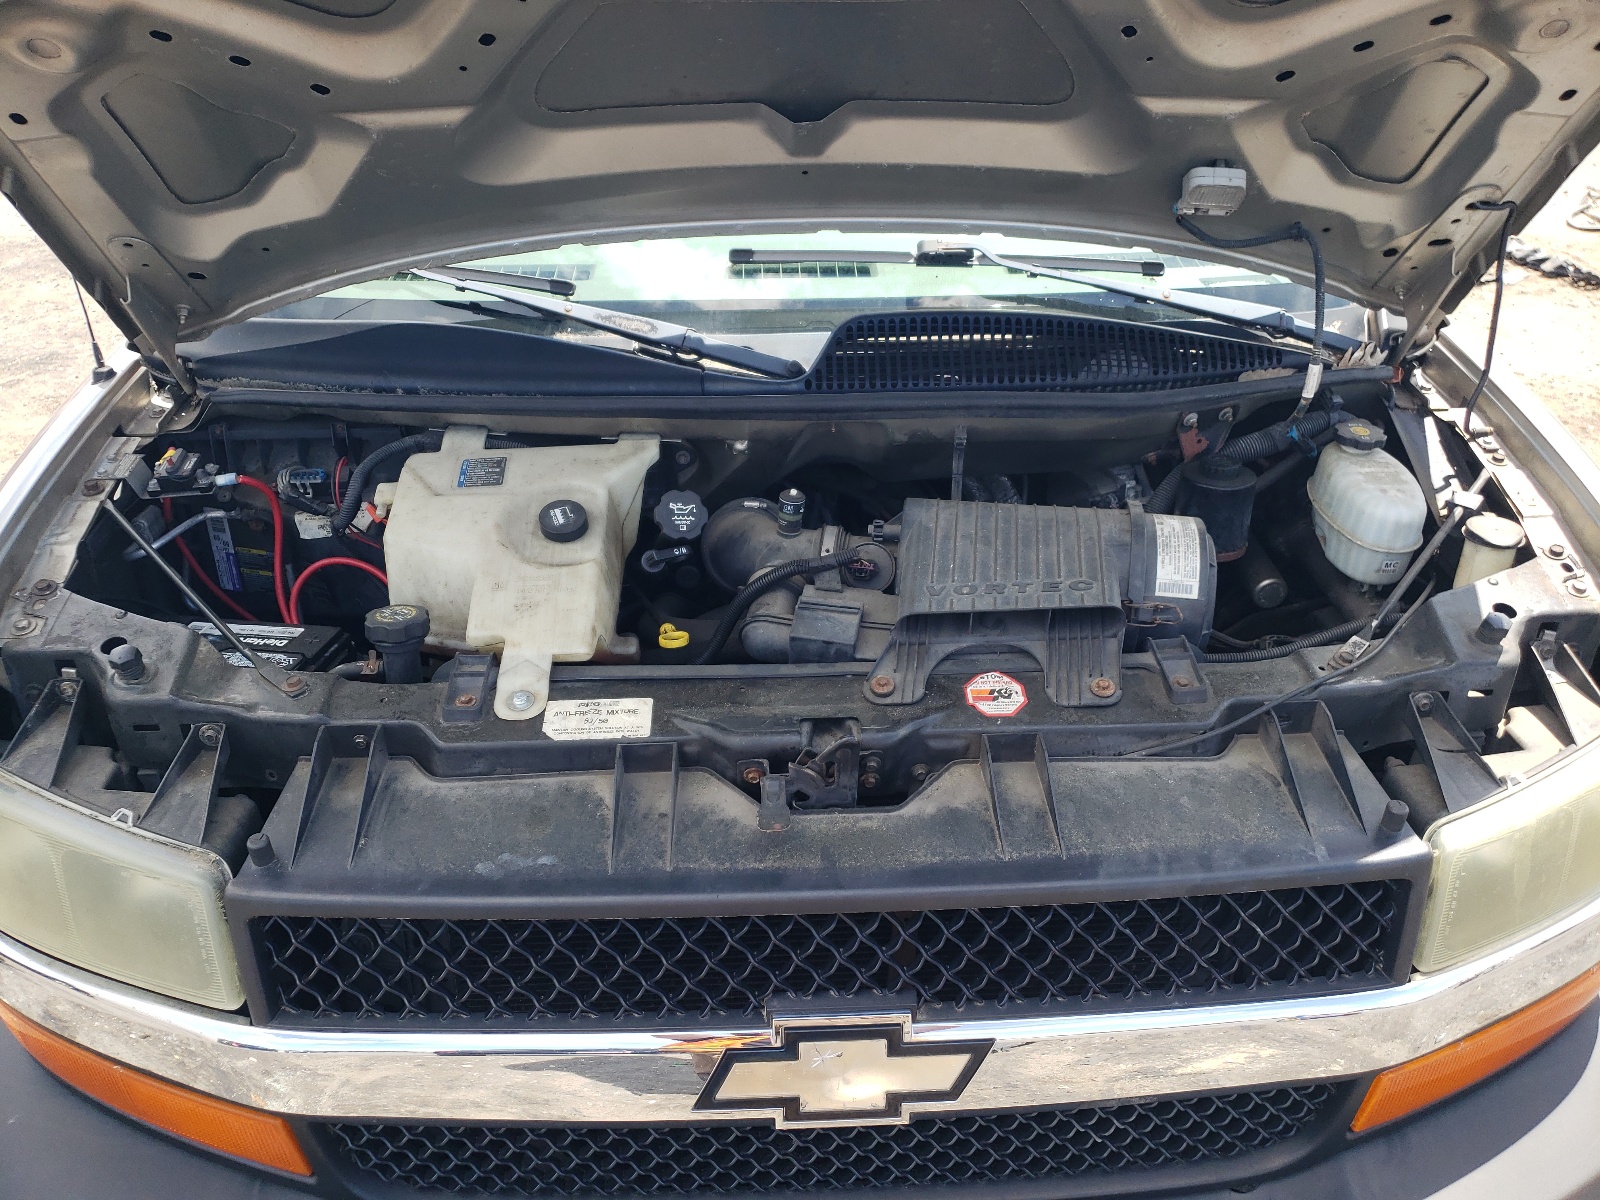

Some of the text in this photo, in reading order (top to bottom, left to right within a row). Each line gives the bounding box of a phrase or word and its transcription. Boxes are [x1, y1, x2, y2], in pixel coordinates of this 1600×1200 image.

[1384, 561, 1399, 569] MC
[925, 579, 1095, 597] VORTEC
[240, 637, 289, 647] DieHar
[606, 708, 639, 716] MIXTURE
